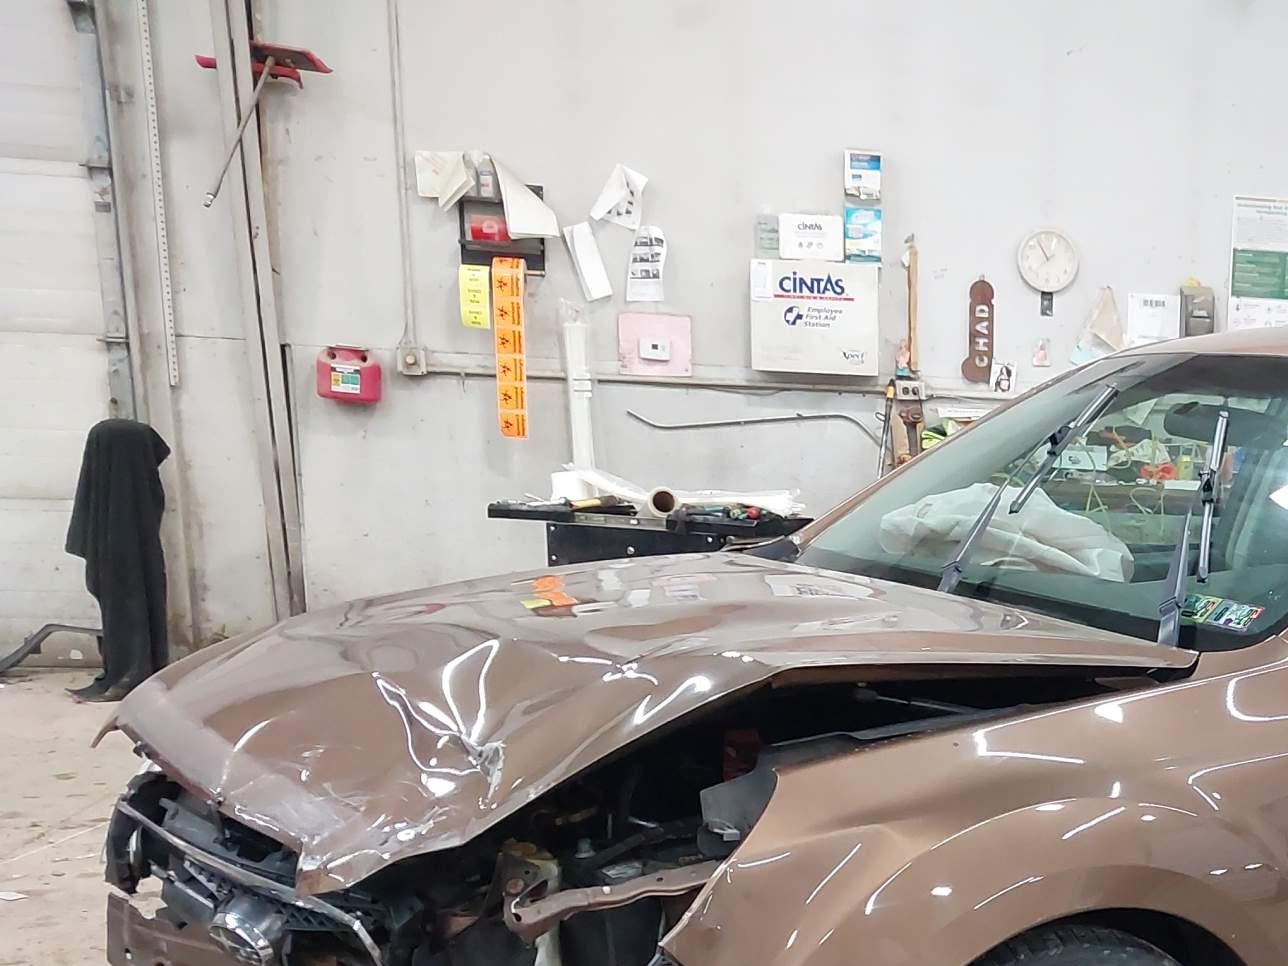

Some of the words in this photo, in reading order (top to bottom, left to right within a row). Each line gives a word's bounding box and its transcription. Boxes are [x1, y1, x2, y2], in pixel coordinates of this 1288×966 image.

[778, 271, 846, 296] CINTAS
[807, 306, 843, 316] Employee
[974, 304, 989, 369] CHAD
